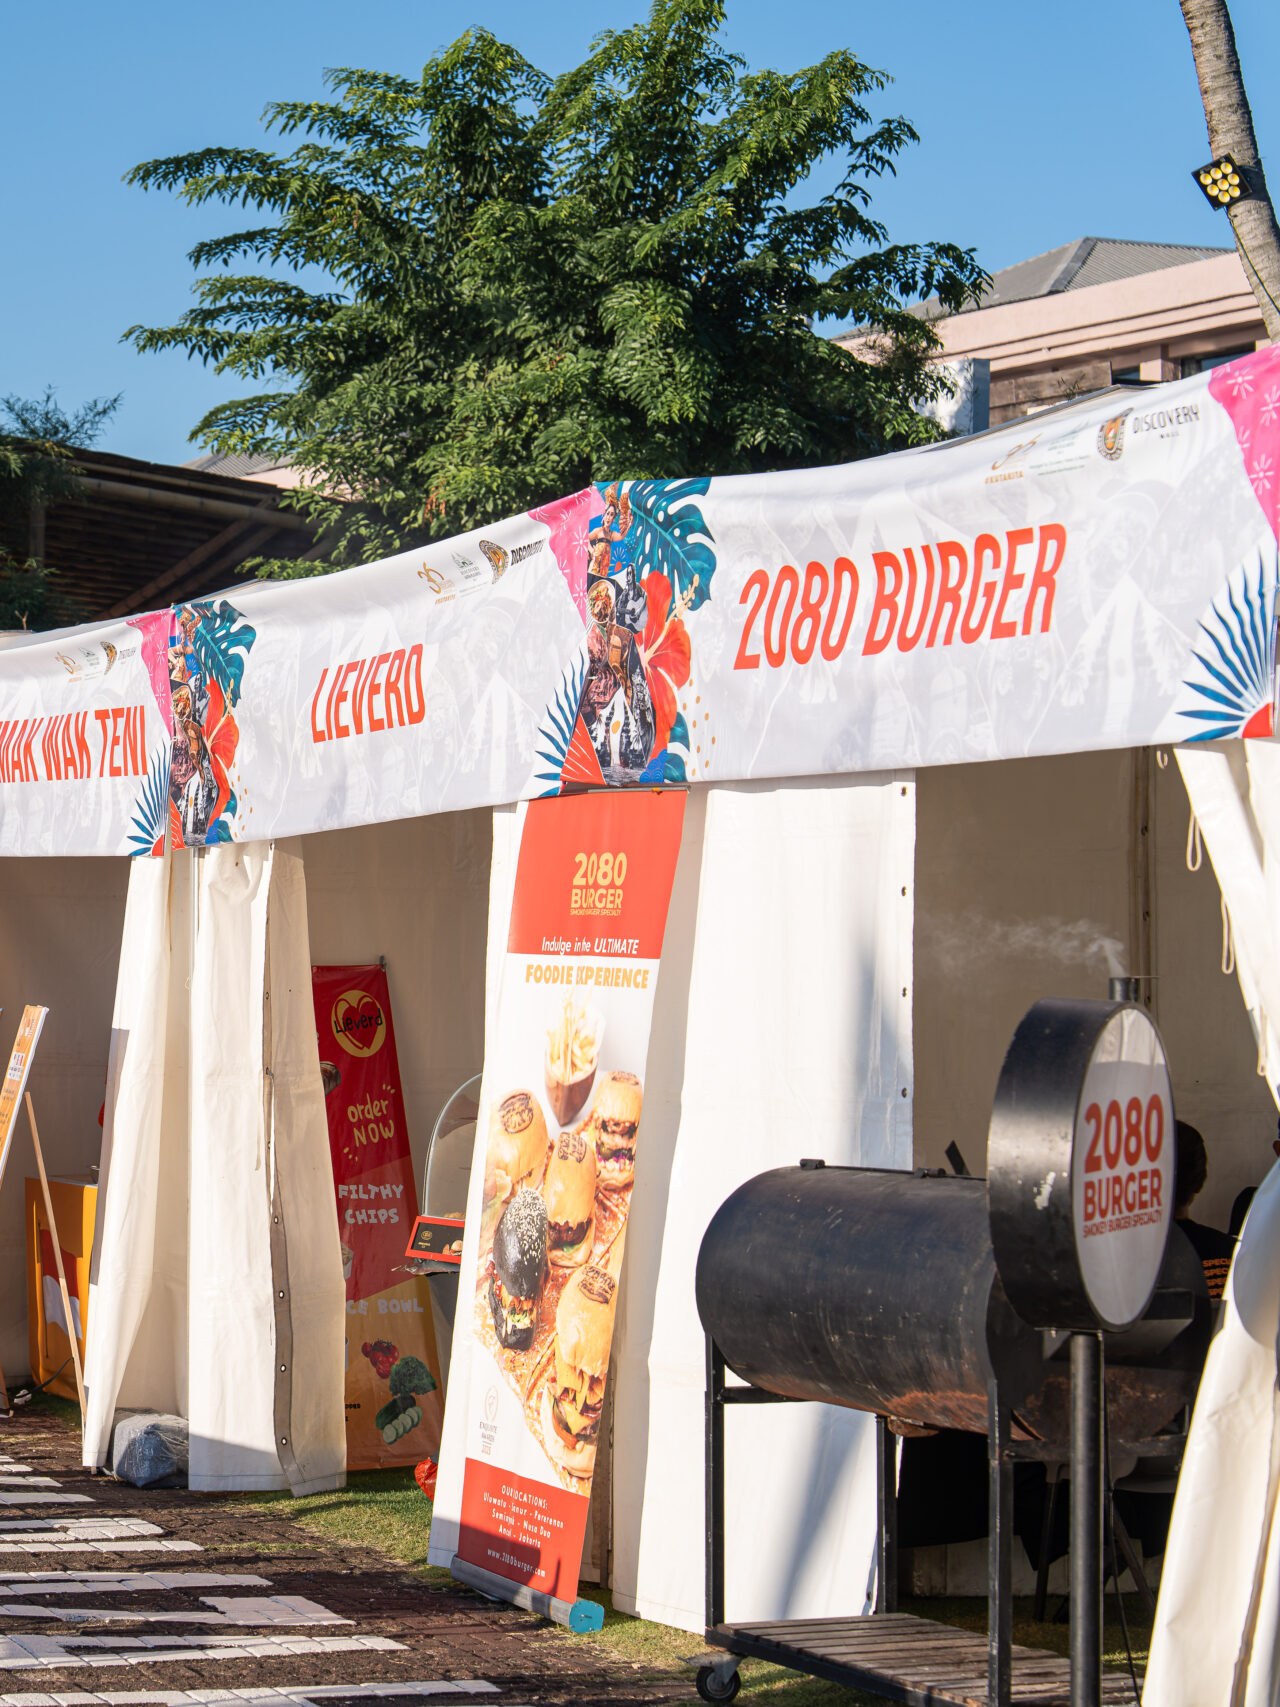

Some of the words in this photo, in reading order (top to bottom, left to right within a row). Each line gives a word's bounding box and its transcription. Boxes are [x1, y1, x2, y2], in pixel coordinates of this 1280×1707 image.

[1133, 404, 1200, 434] DISCOVERY
[733, 557, 860, 670] 2080
[862, 523, 1067, 656] BURGER
[311, 643, 426, 744] LIEVERD
[41, 711, 92, 781] WAK
[94, 705, 148, 777] TENI
[572, 852, 627, 886] 2080
[570, 888, 624, 908] BURGER
[542, 936, 571, 955] Indulge
[593, 938, 639, 954] ULTIMATE
[525, 964, 573, 985] FOODIE
[576, 966, 649, 989] EXPERIENCE
[334, 1008, 383, 1034] Lieverd
[347, 1092, 388, 1122] order
[353, 1119, 394, 1147] NOW
[1085, 1093, 1164, 1174] 2080
[338, 1184, 404, 1199] FILTHY
[1083, 1168, 1162, 1222] BURGER
[345, 1208, 399, 1225] CHIPS
[1108, 1216, 1132, 1232] BURGER
[377, 1298, 424, 1314] BOWL
